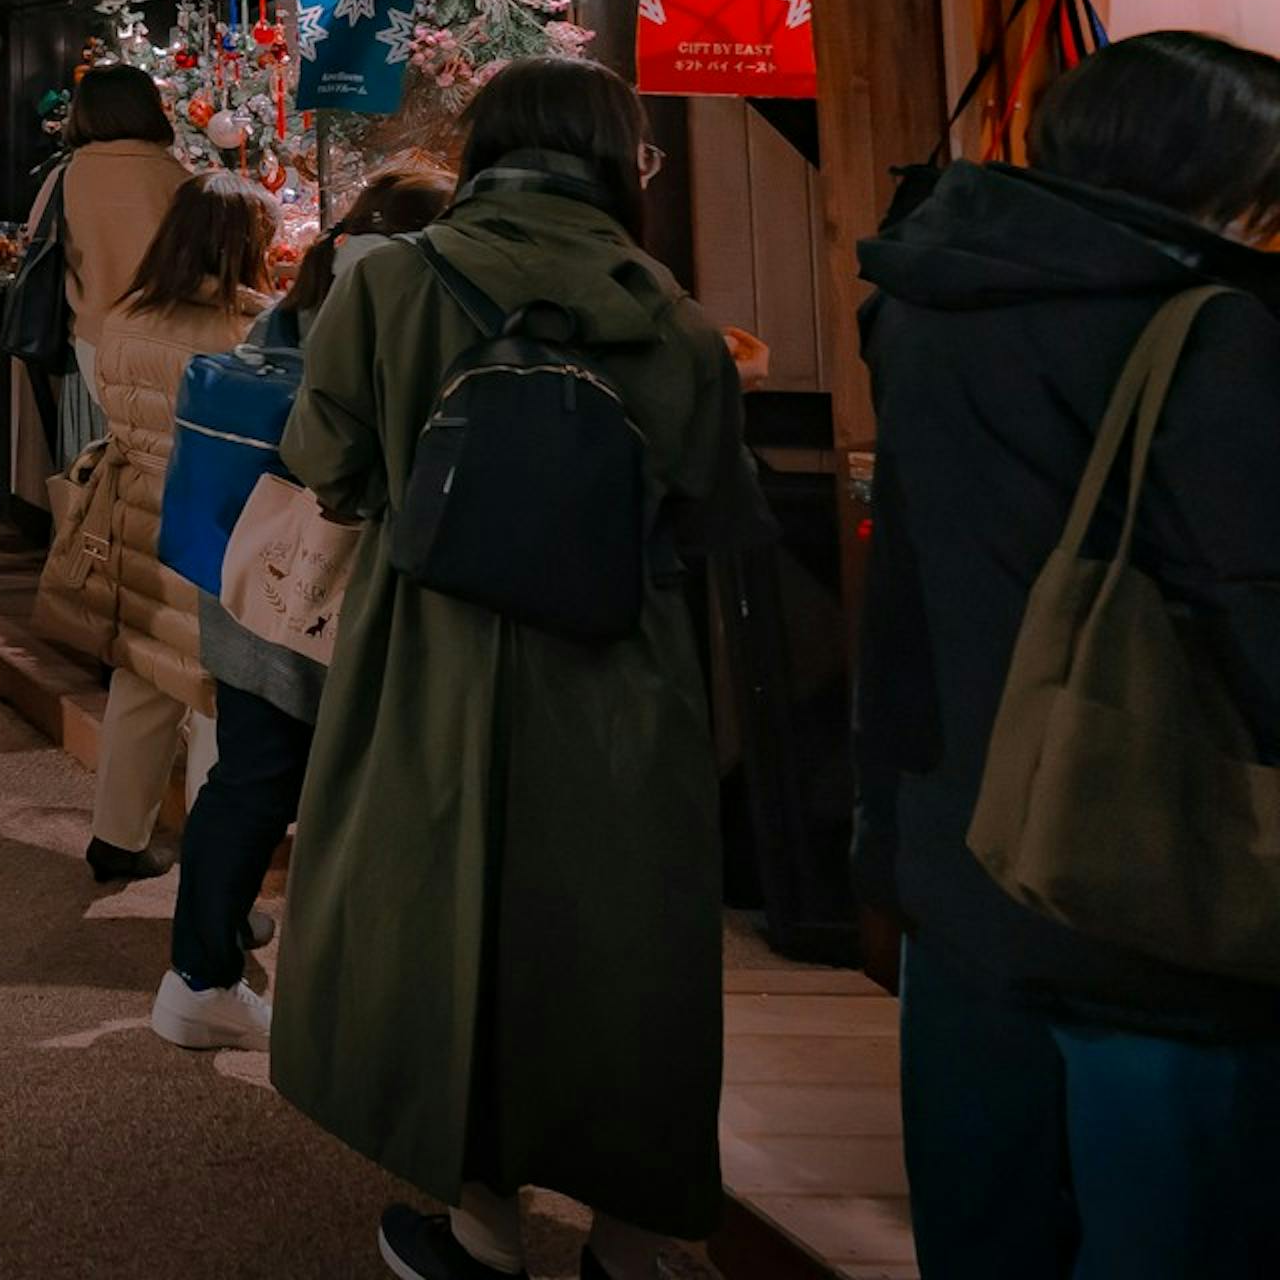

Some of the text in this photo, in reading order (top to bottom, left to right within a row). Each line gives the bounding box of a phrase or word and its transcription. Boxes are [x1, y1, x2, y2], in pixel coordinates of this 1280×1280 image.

[677, 41, 774, 56] GIFT BY EAST
